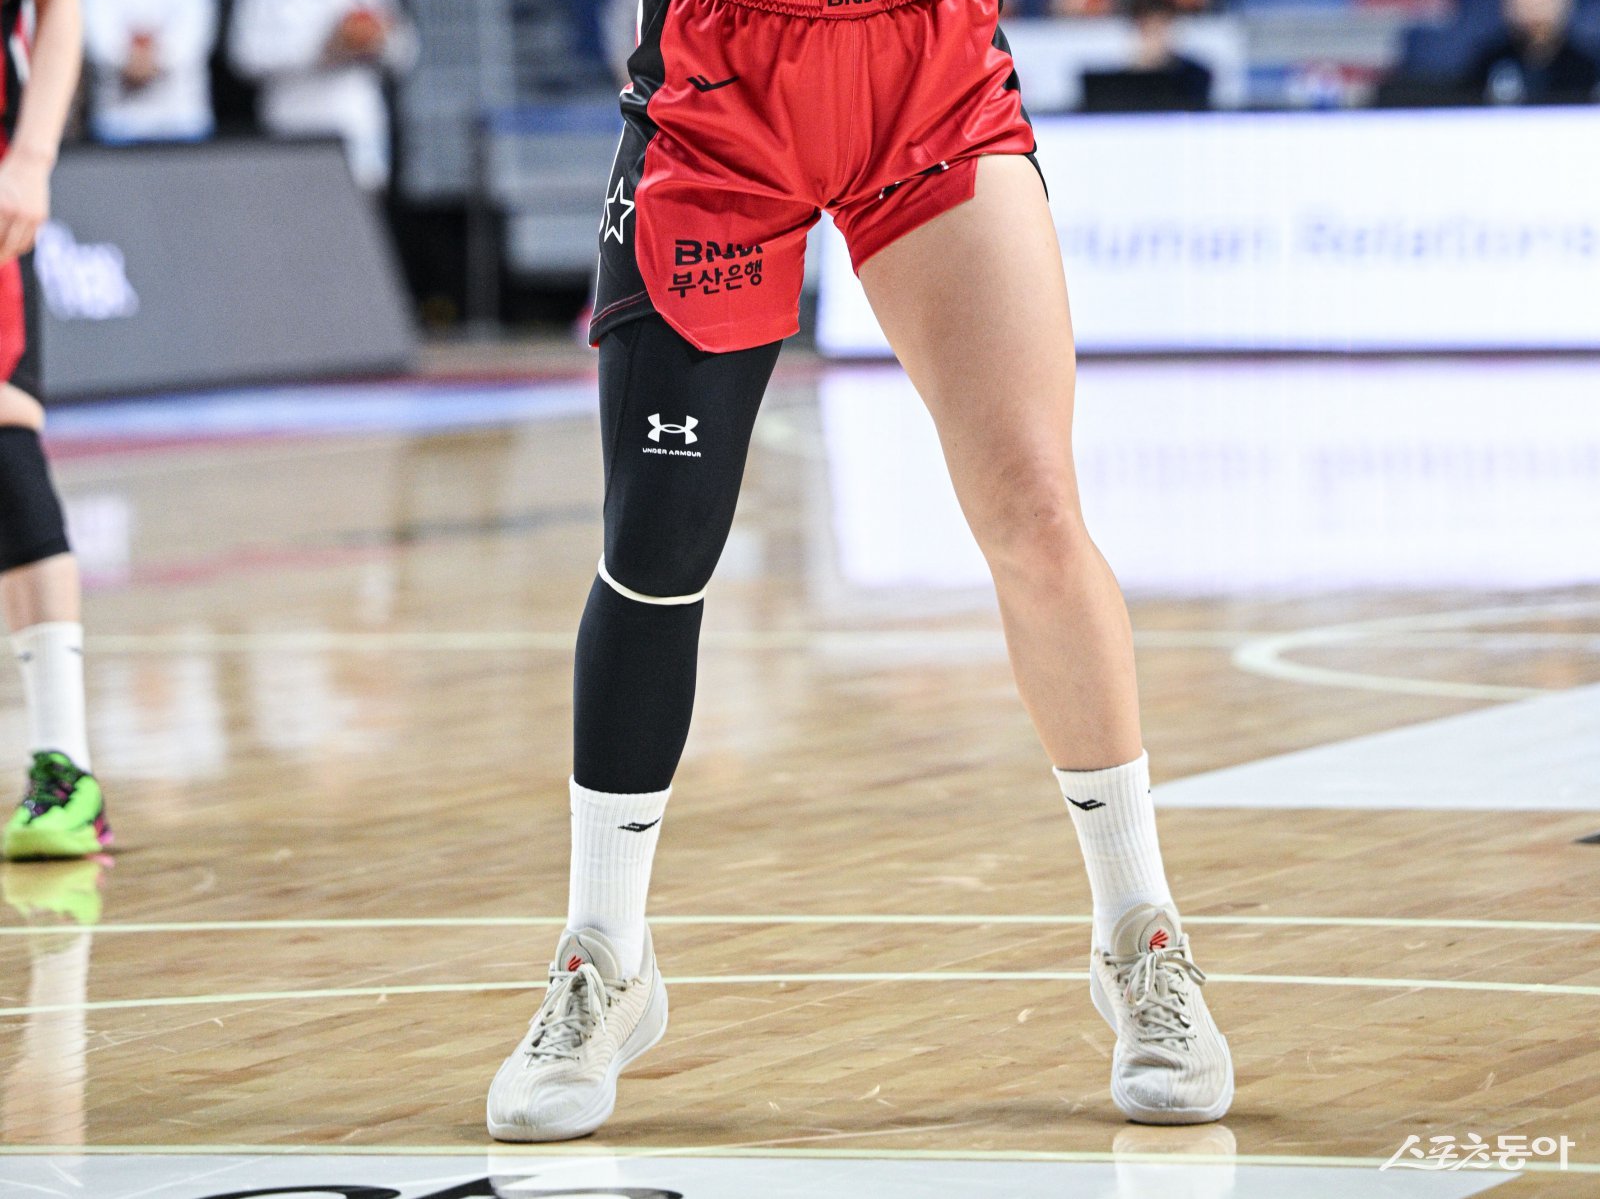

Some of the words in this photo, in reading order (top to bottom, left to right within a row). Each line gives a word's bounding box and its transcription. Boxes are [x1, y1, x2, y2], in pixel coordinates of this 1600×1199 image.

[668, 258, 763, 298] 부산은행
[642, 447, 668, 455] UNDER
[668, 449, 702, 458] ARMOUR
